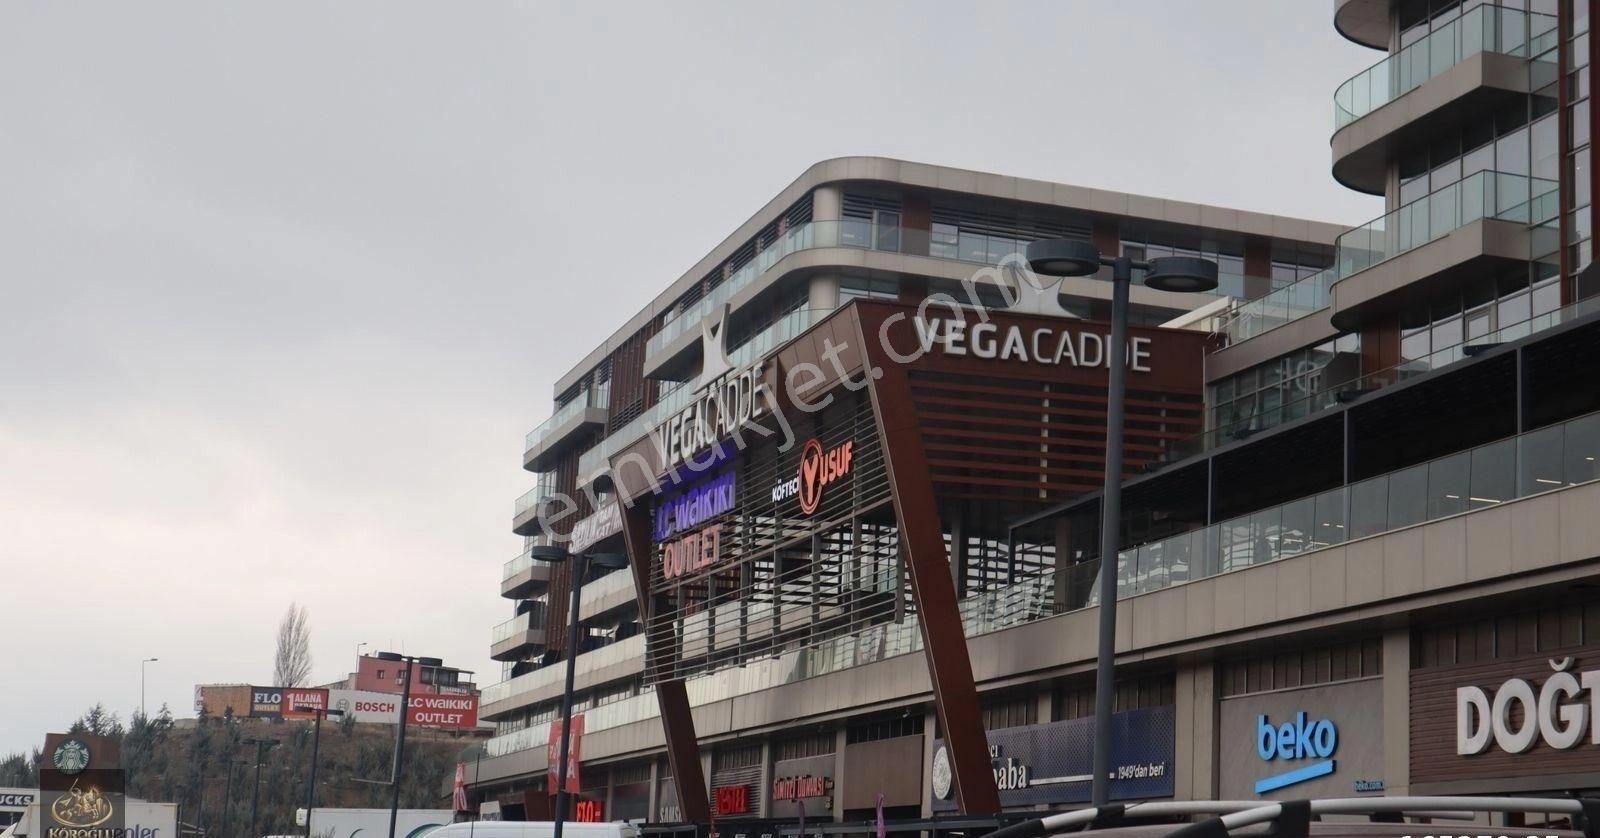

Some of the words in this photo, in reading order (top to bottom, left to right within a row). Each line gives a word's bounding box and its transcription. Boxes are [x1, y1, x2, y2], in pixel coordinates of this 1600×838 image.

[659, 361, 764, 470] VEGACADDE
[803, 441, 852, 505] YUSUF
[663, 524, 722, 580] OUTLET
[254, 692, 282, 704] FLO
[295, 693, 322, 703] ALANA
[408, 697, 424, 708] LC
[355, 702, 395, 713] BOSCH
[415, 712, 463, 724] OUTLET
[1257, 711, 1340, 760] beko
[993, 757, 1028, 790] aba
[1149, 761, 1165, 777] beri
[660, 806, 682, 823] SAMS
